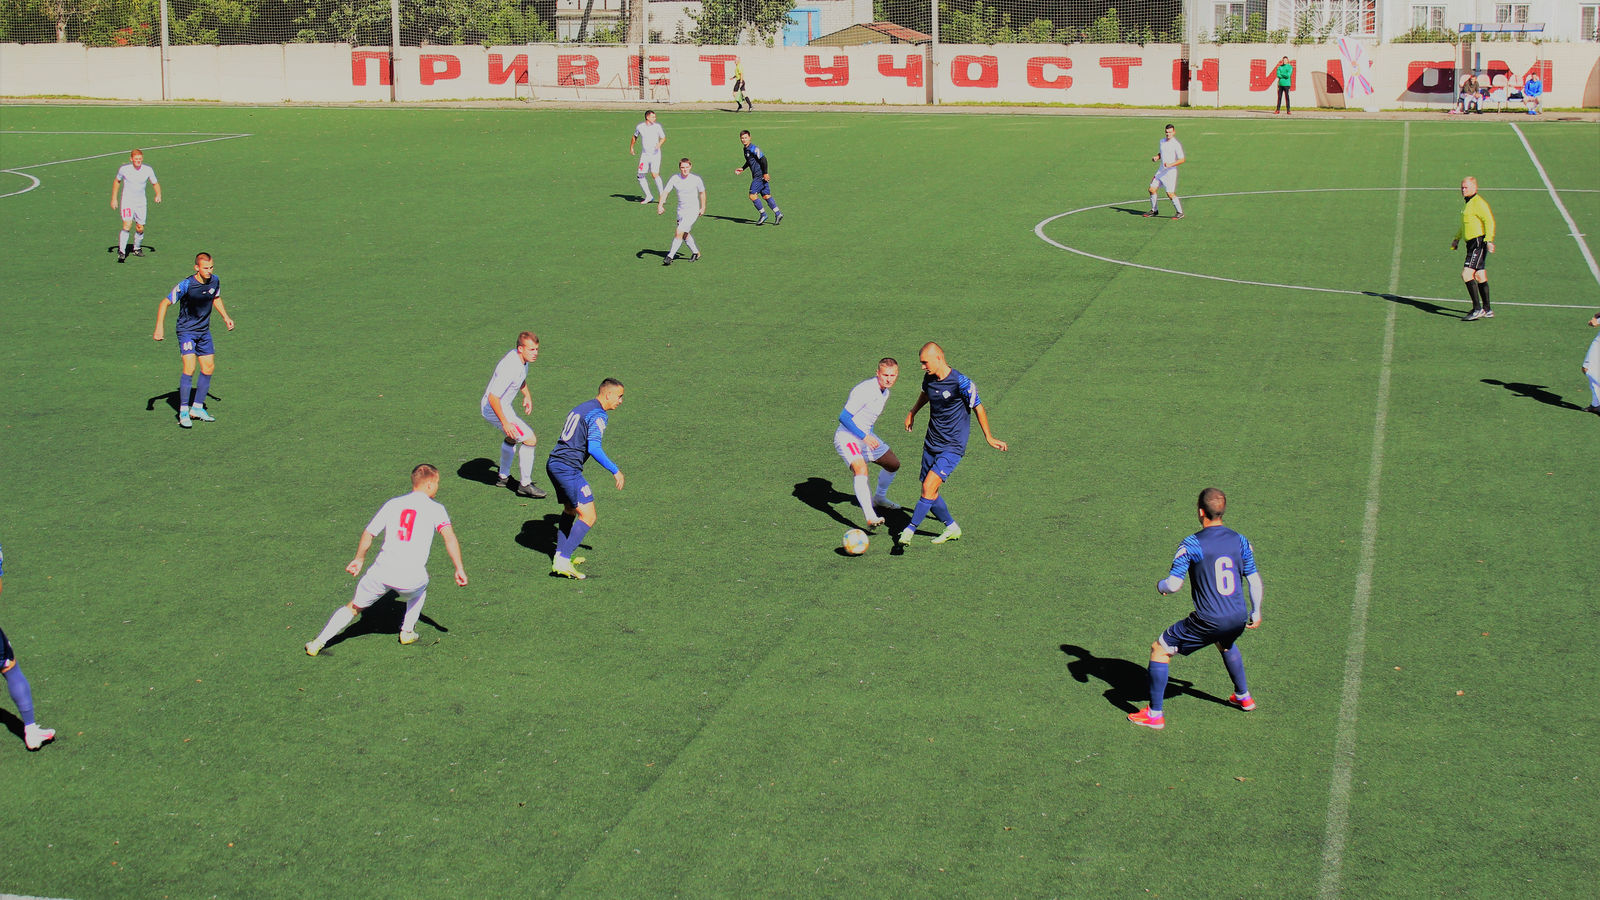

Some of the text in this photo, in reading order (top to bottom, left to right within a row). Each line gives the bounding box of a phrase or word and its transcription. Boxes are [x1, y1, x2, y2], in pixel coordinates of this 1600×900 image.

[351, 51, 737, 86] ПРИВЕТ
[122, 207, 132, 218] 13
[560, 411, 581, 442] 10
[397, 508, 417, 542] 9
[1214, 556, 1236, 597] 6
